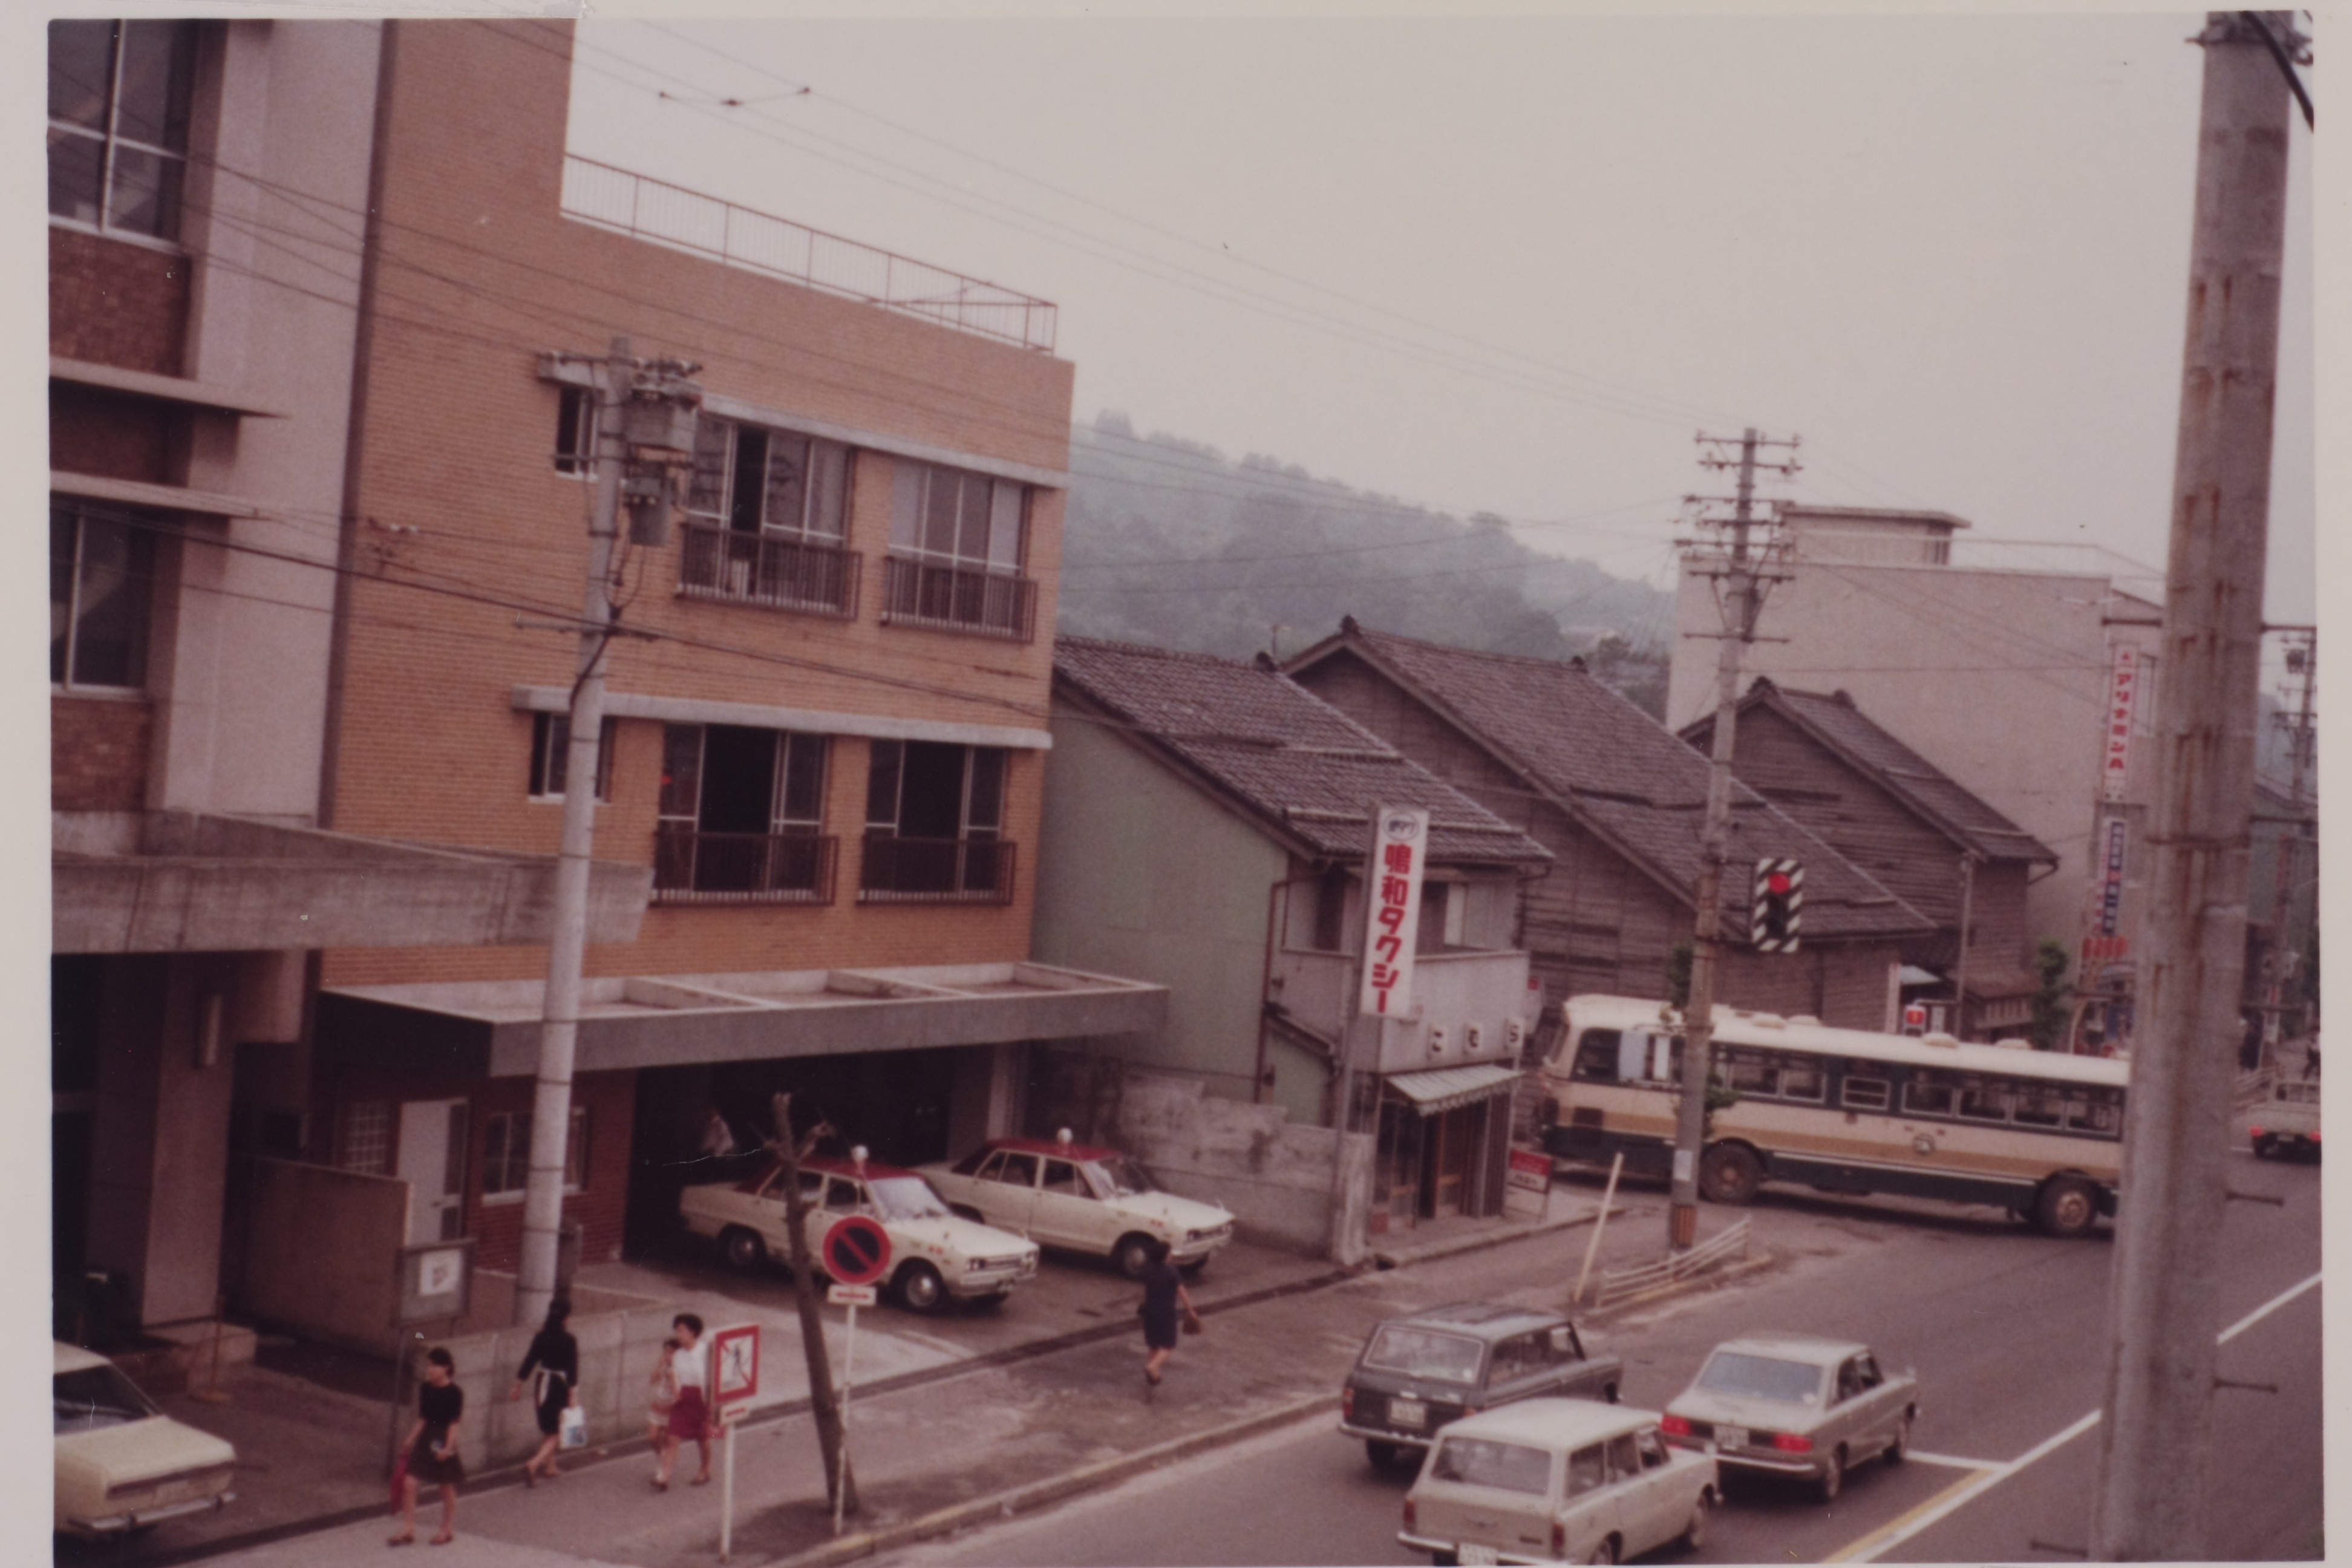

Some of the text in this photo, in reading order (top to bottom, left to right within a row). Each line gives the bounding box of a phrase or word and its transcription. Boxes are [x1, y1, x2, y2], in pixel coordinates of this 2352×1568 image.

[1372, 844, 1413, 1013] 鳴和タクシー
